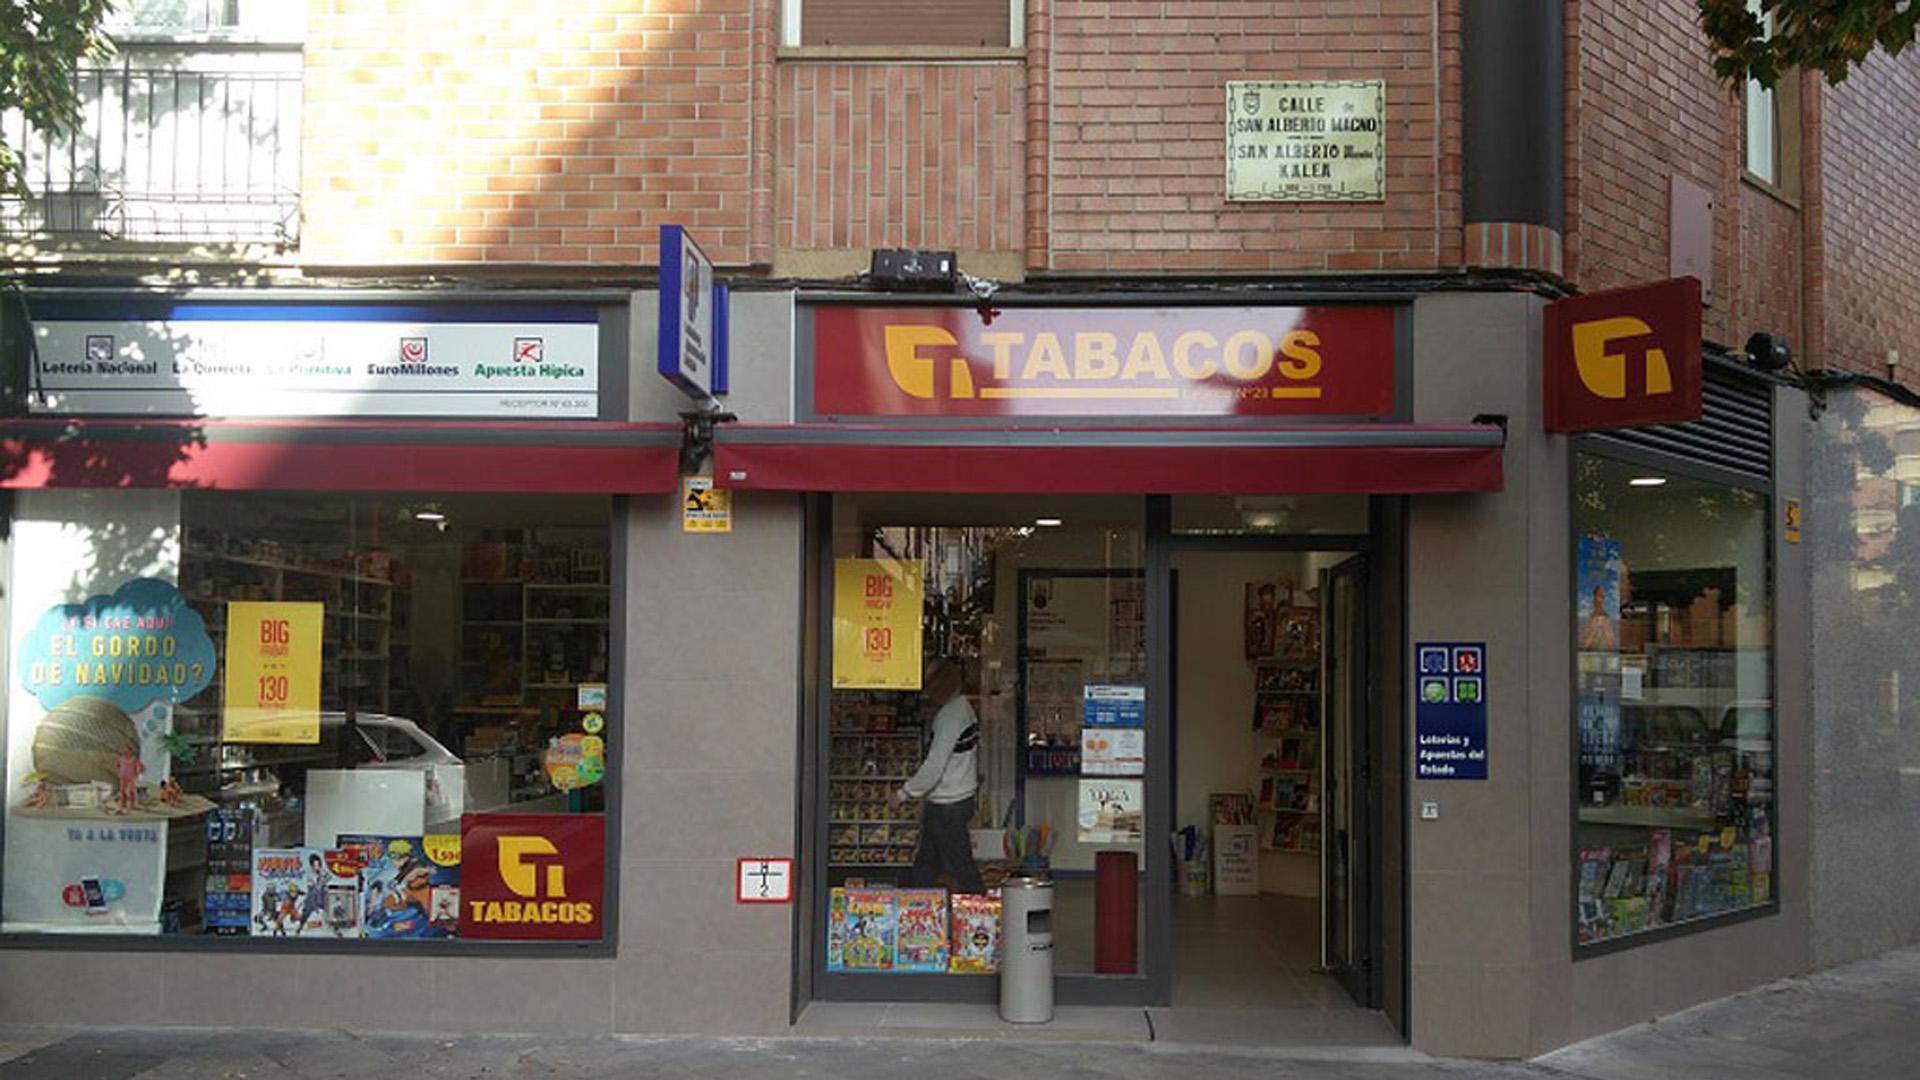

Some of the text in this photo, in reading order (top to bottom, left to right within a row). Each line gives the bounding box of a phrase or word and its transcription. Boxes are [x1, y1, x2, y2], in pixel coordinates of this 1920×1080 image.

[1278, 97, 1325, 113] CALLE
[1237, 118, 1376, 132] SAN ALBERTO MAGNO
[1237, 145, 1268, 158] SAN
[1275, 145, 1339, 158] ALBERTO
[1279, 164, 1331, 178] KALEA
[980, 330, 1322, 380] TABACOS
[97, 361, 157, 374] Nacional
[367, 363, 459, 376] EuroMillones
[474, 363, 536, 378] Apuesta
[865, 575, 892, 597] BIG
[260, 619, 289, 643] BIG
[865, 627, 892, 650] 130
[51, 636, 177, 656] EL GORDO
[31, 662, 203, 684] DE NAVIDAD?
[259, 675, 288, 701] 130
[1420, 750, 1466, 761] Apuestas
[1420, 764, 1455, 775] Estado
[470, 900, 593, 923] TABACOS
